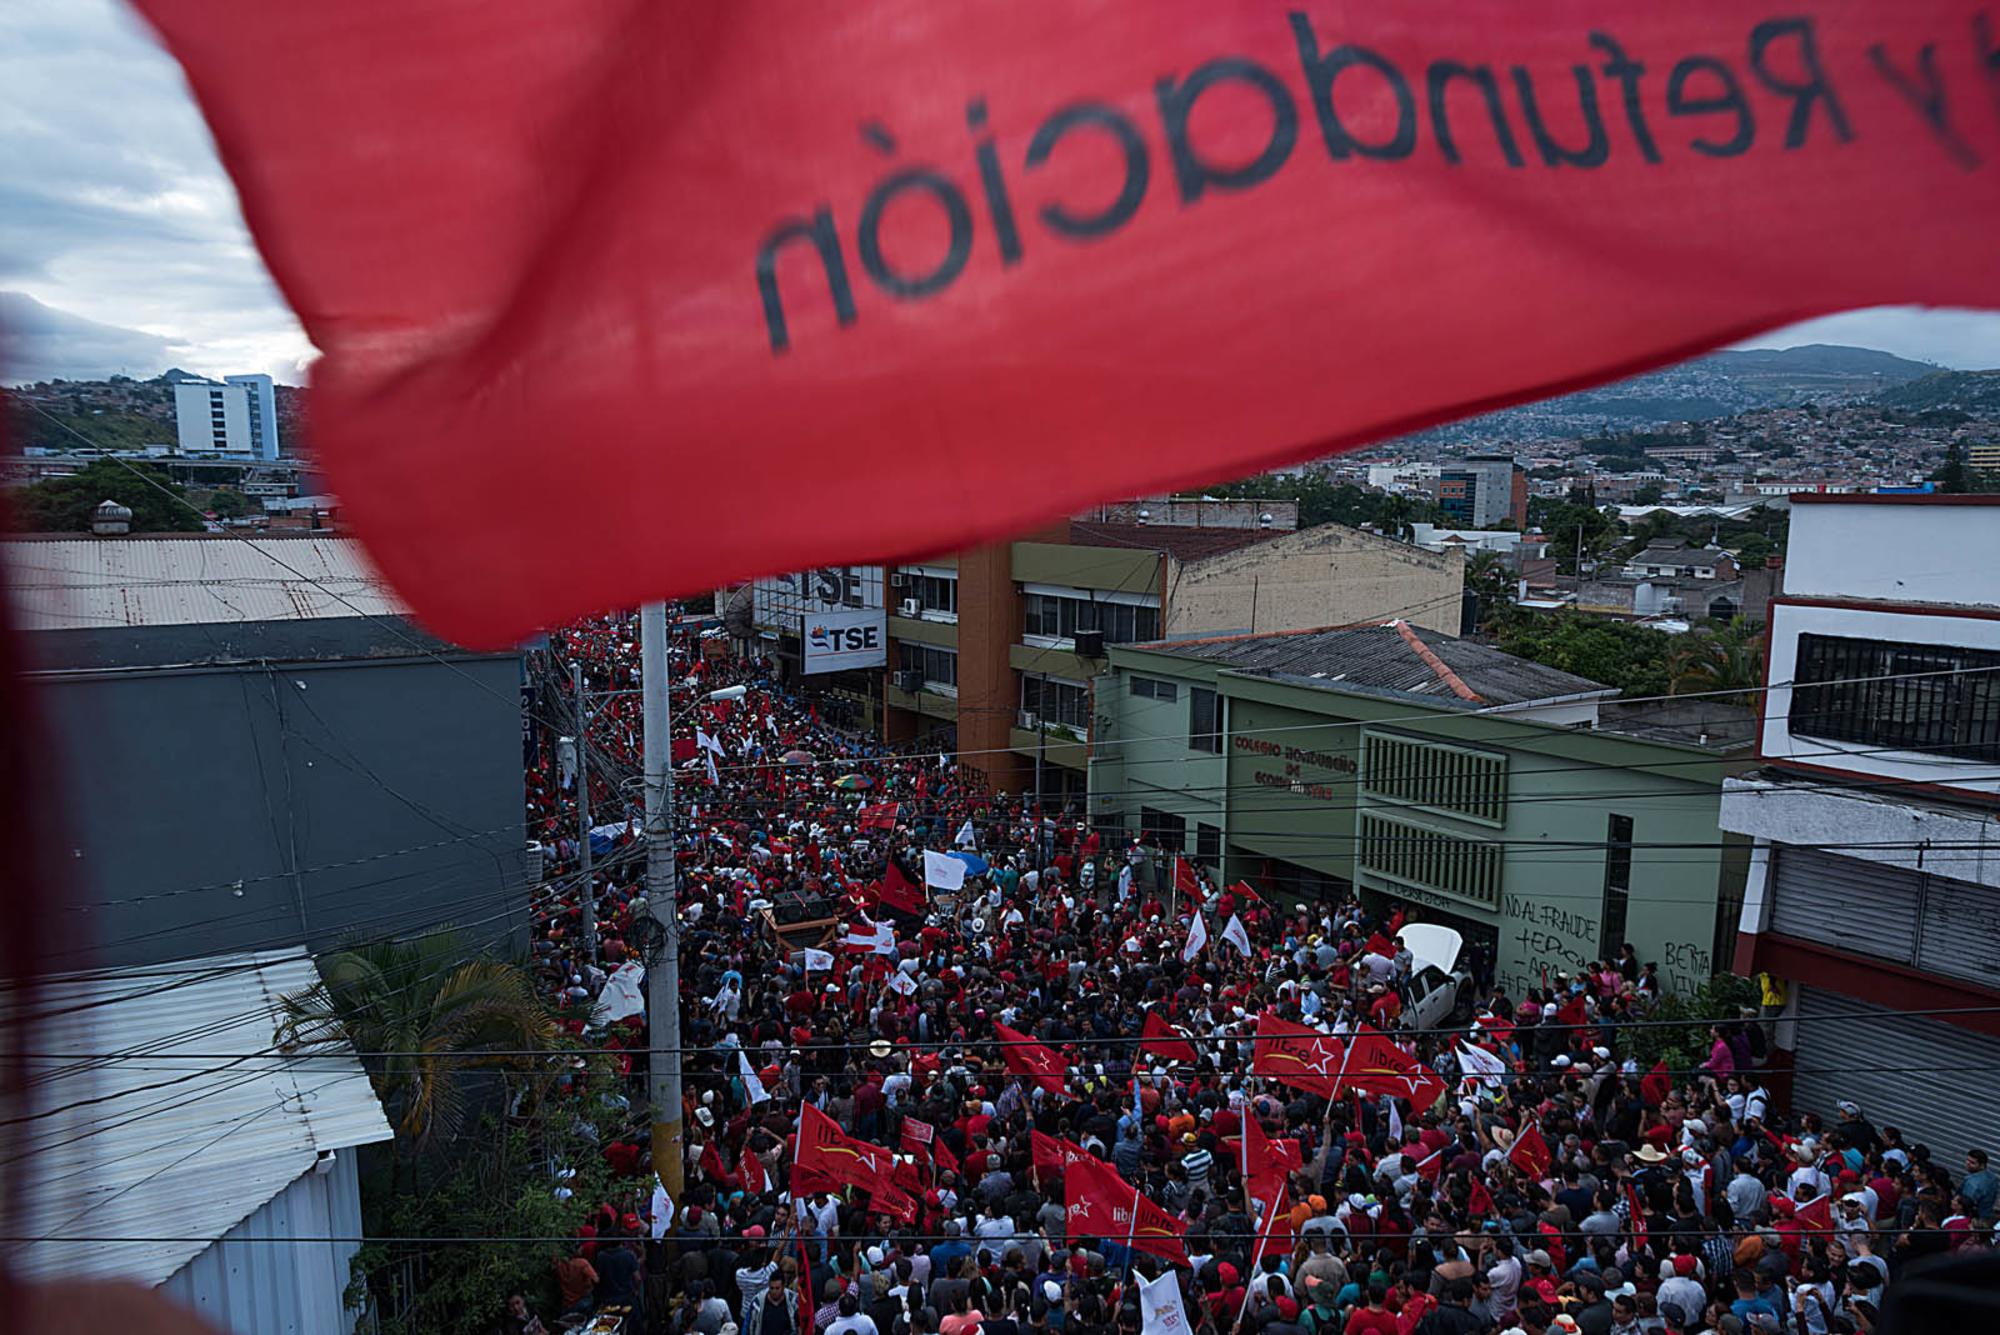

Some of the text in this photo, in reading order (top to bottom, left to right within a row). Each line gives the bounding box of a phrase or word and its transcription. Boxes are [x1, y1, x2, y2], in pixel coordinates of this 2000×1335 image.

[829, 626, 878, 652] TSE
[1235, 736, 1281, 756] COLEGIO
[1504, 894, 1598, 944] NO AL FRAUDE
[1665, 942, 1710, 976] BERTA
[1369, 1046, 1407, 1073] libre
